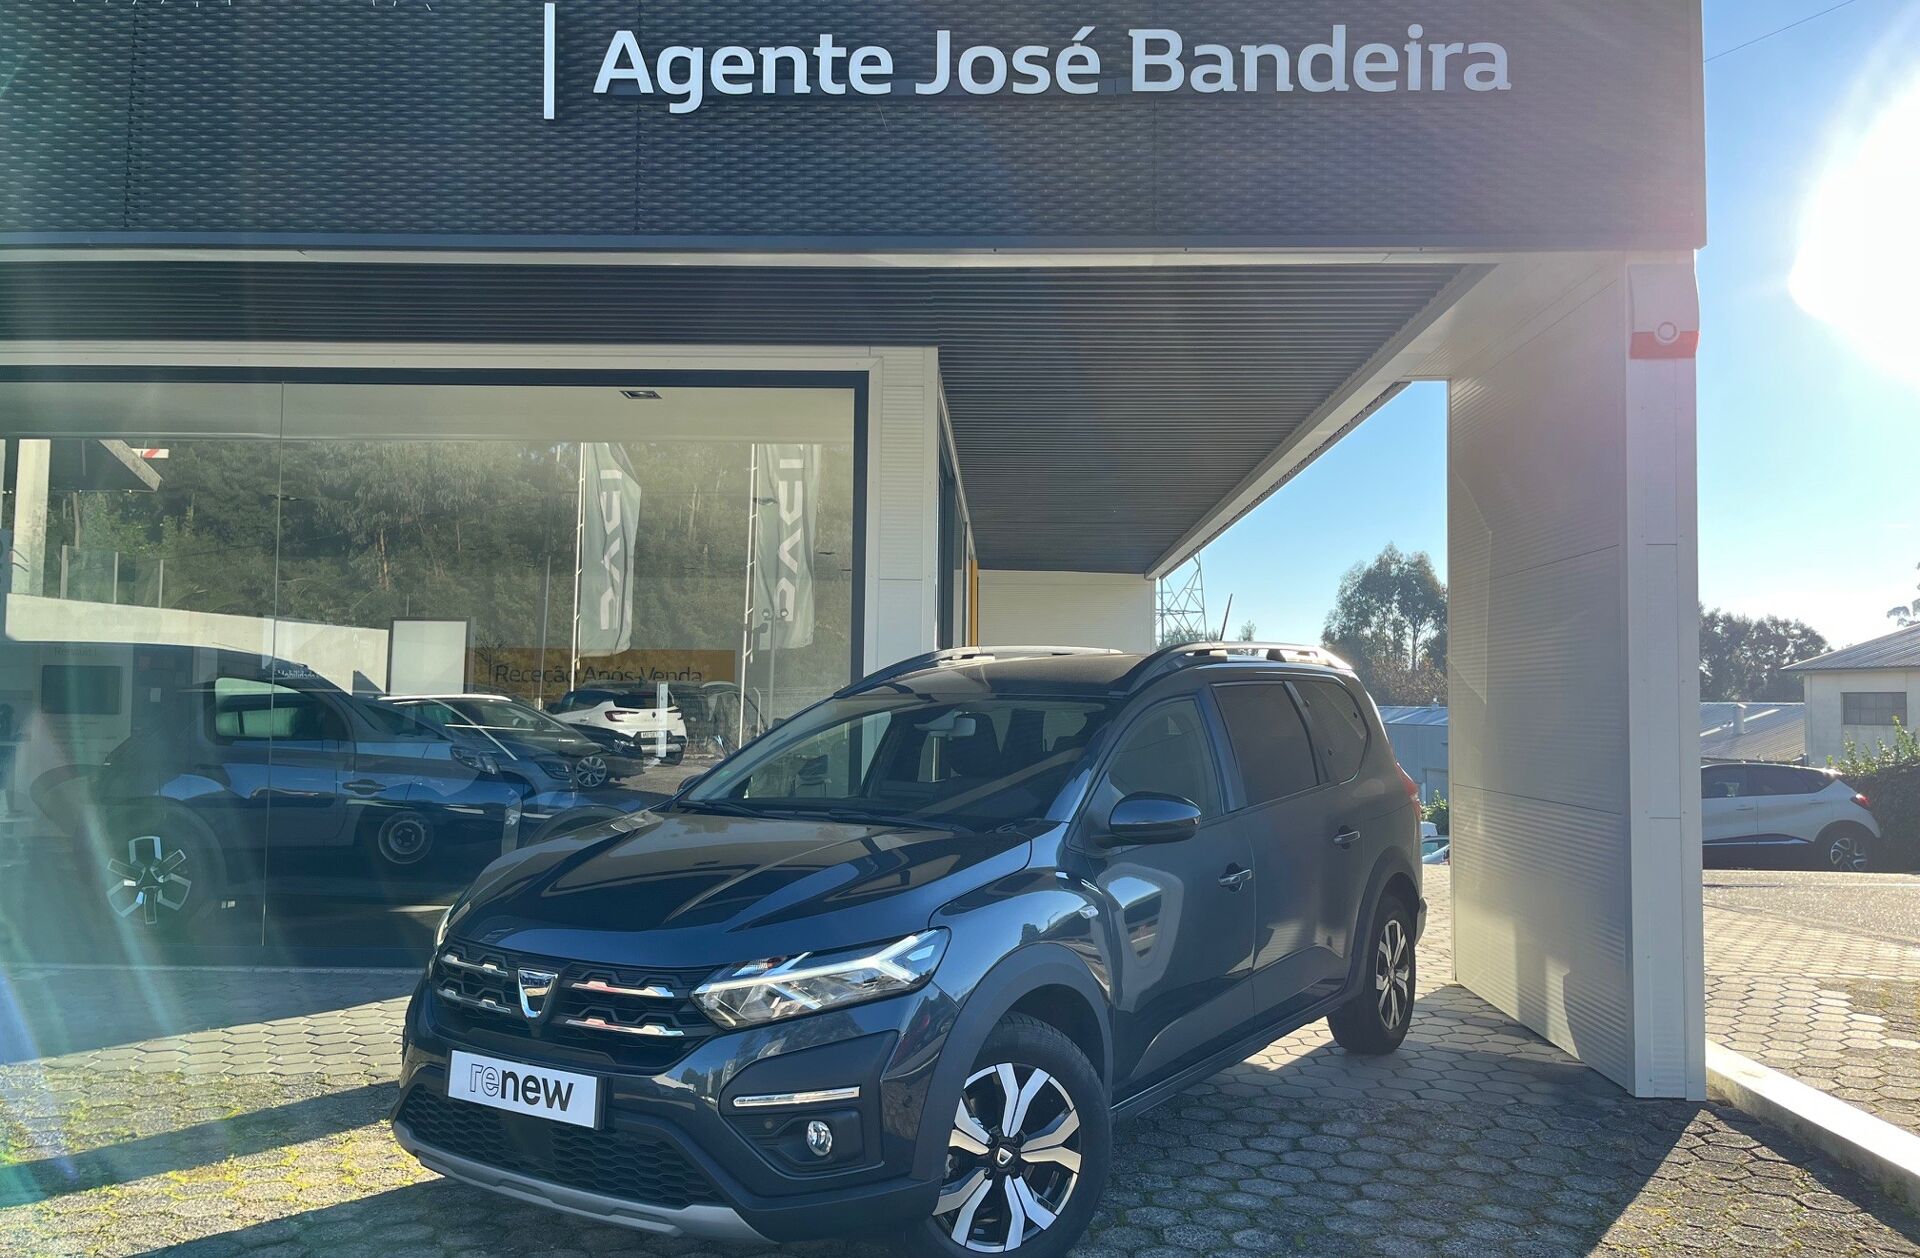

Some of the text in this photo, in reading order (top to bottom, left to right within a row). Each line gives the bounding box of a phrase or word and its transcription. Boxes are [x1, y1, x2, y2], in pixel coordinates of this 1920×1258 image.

[593, 24, 1512, 114] Agente José Bandeira
[469, 1063, 574, 1112] renew
